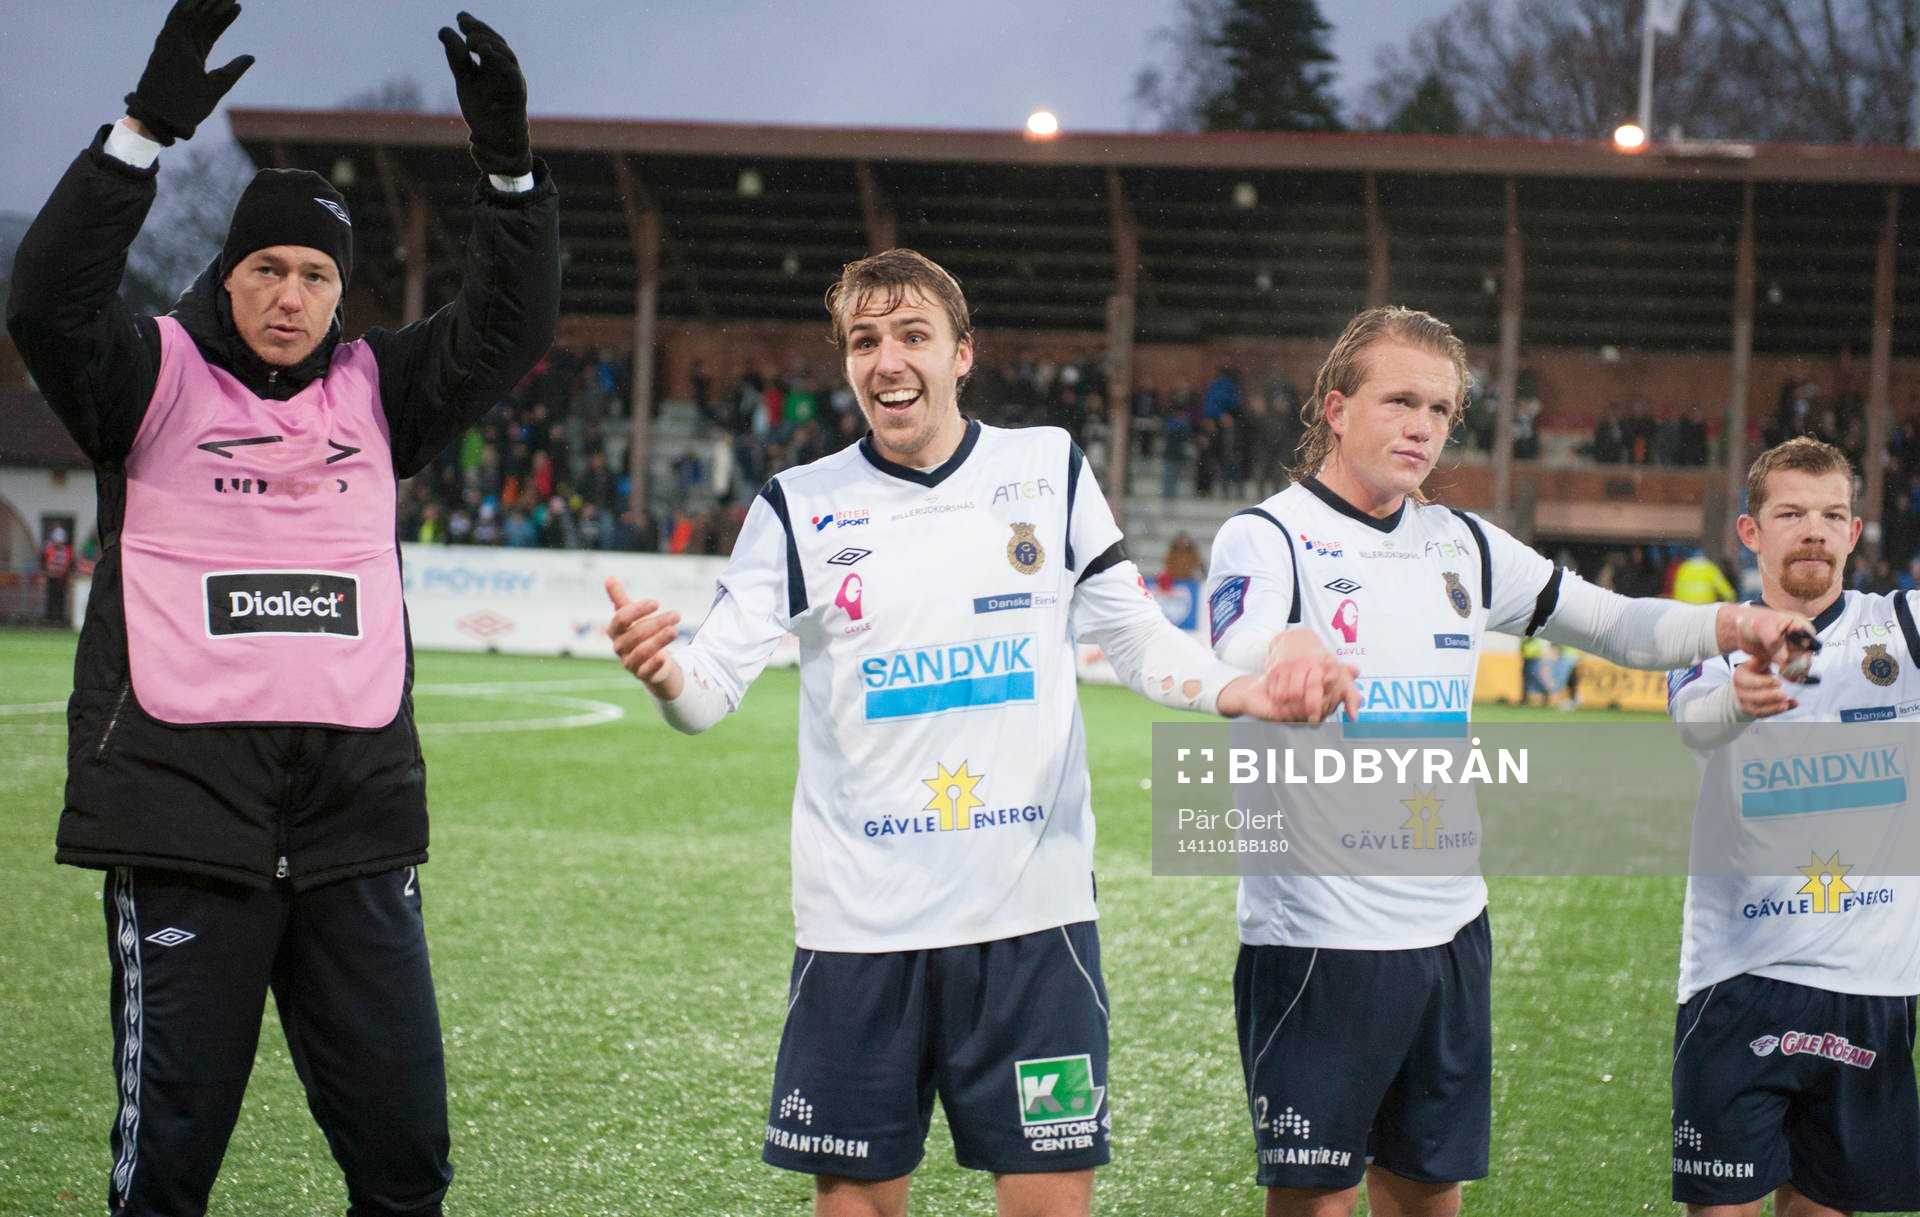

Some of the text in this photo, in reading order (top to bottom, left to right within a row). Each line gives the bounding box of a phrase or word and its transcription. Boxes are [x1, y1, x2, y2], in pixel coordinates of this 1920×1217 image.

[992, 478, 1055, 504] ATER
[835, 509, 870, 519] INTER
[837, 517, 870, 528] SPORT
[229, 591, 342, 618] Dialect
[862, 637, 1032, 688] SANDVIK
[1742, 746, 1902, 791] SANDVIK
[864, 805, 1045, 837] GÄVLE ENERGI
[1340, 830, 1410, 850] GÄVLE
[1743, 898, 1809, 919] GÄVLE
[1023, 1121, 1099, 1138] KONTORS
[1031, 1135, 1095, 1152] CENTER
